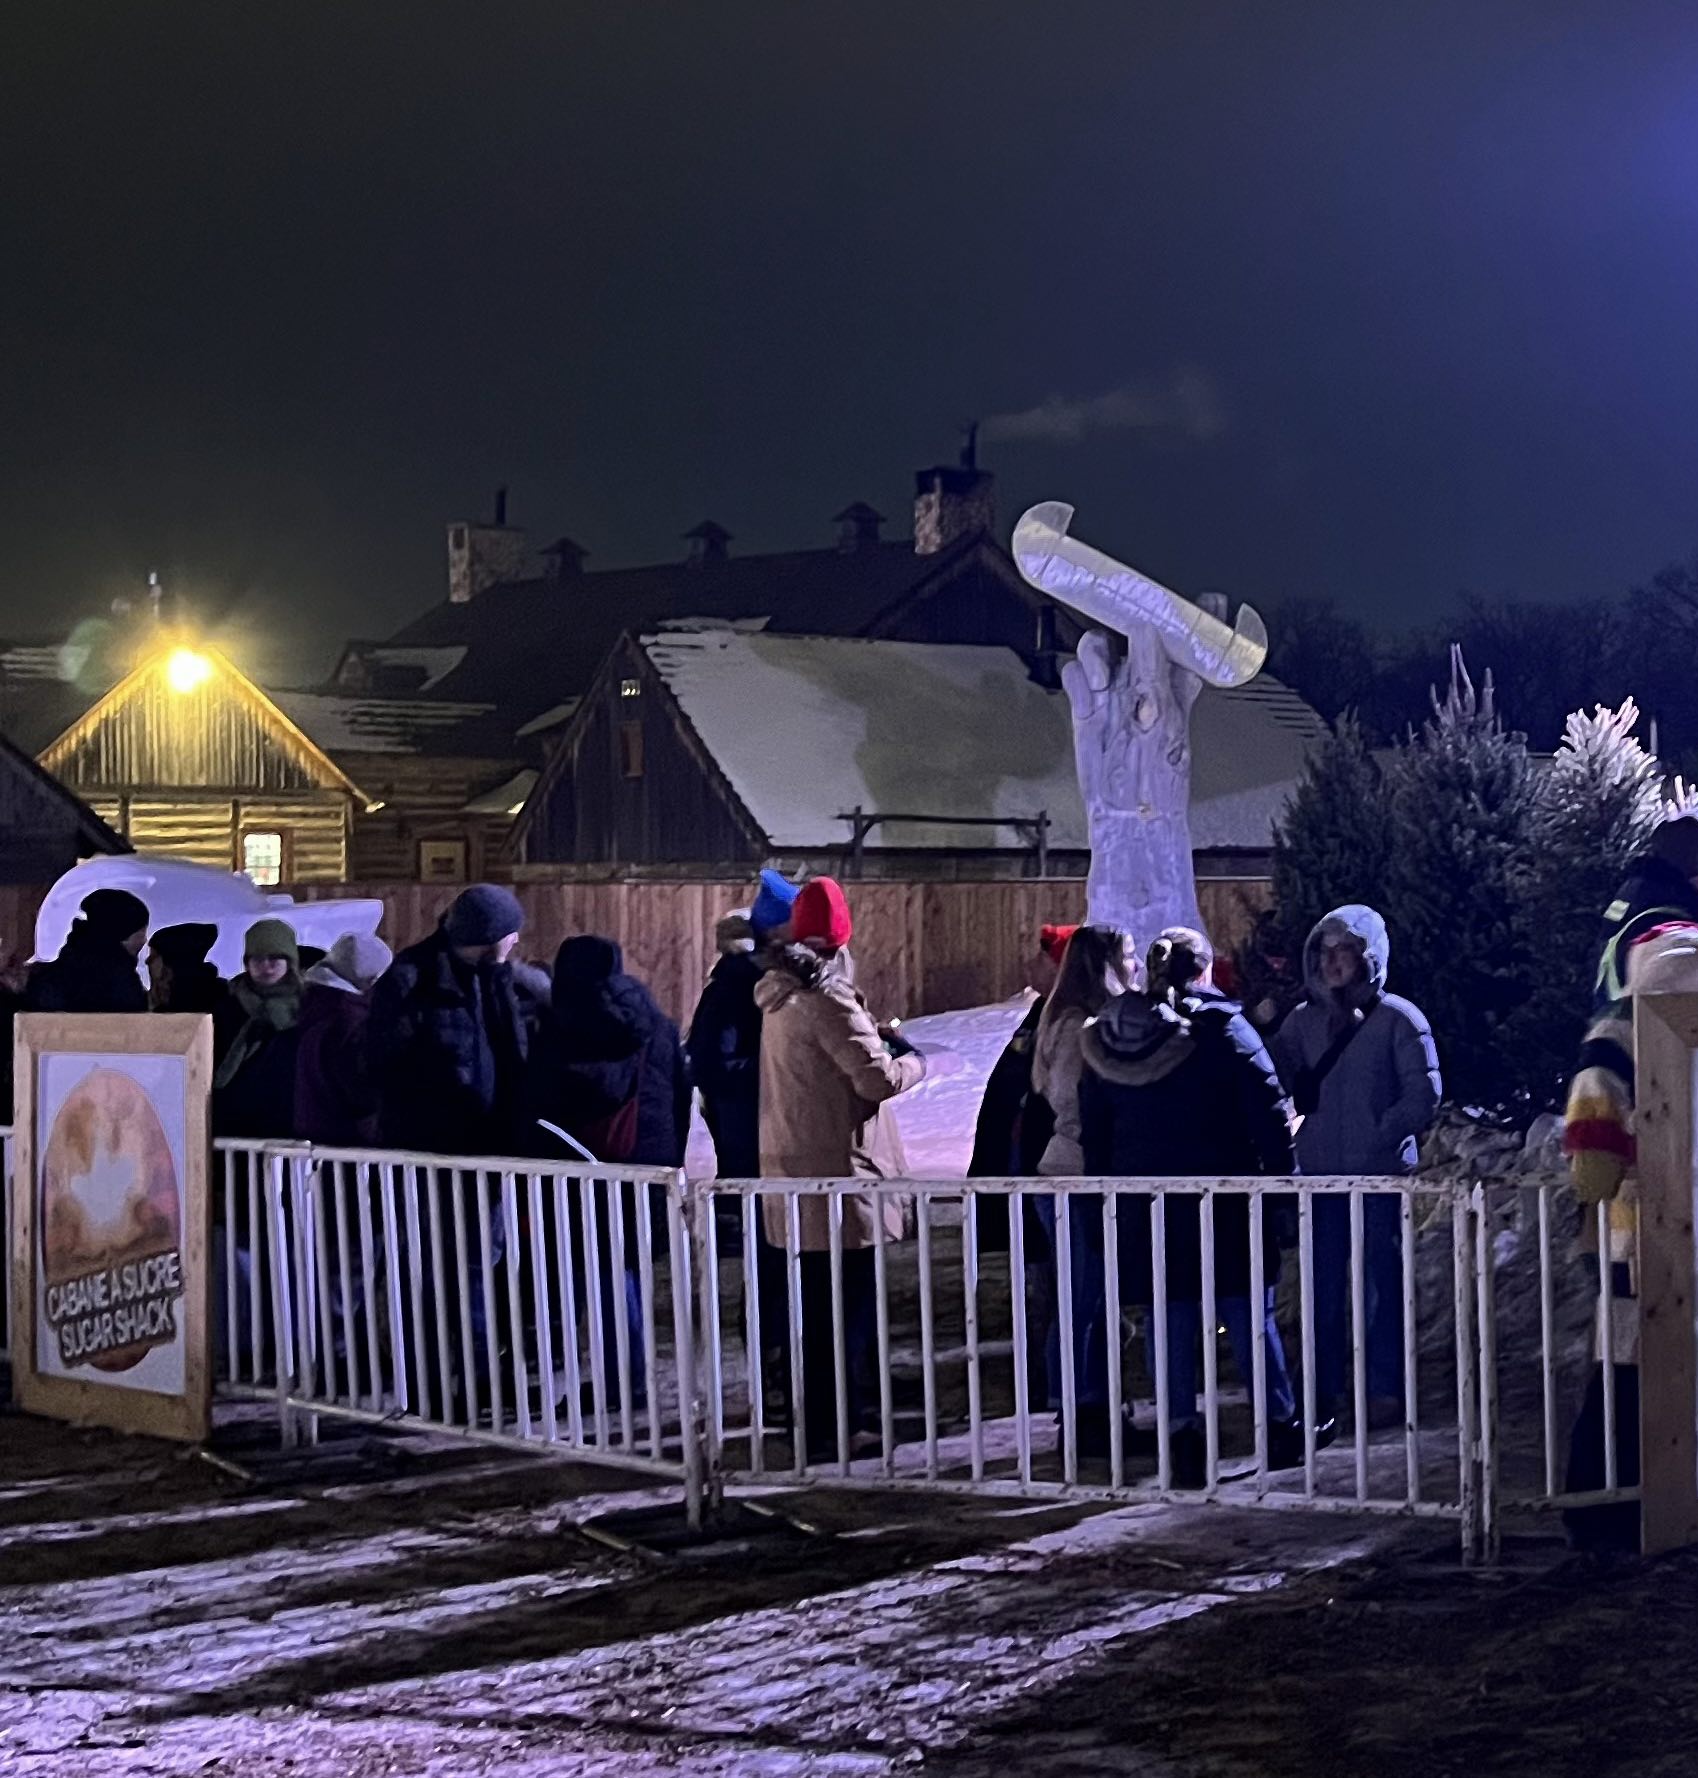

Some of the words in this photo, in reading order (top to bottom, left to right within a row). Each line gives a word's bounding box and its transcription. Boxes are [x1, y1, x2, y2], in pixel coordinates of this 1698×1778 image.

[47, 1271, 110, 1321] CABANE
[122, 1252, 180, 1300] SUCRE
[61, 1312, 116, 1358] SUGAR
[114, 1297, 172, 1344] SHACK
